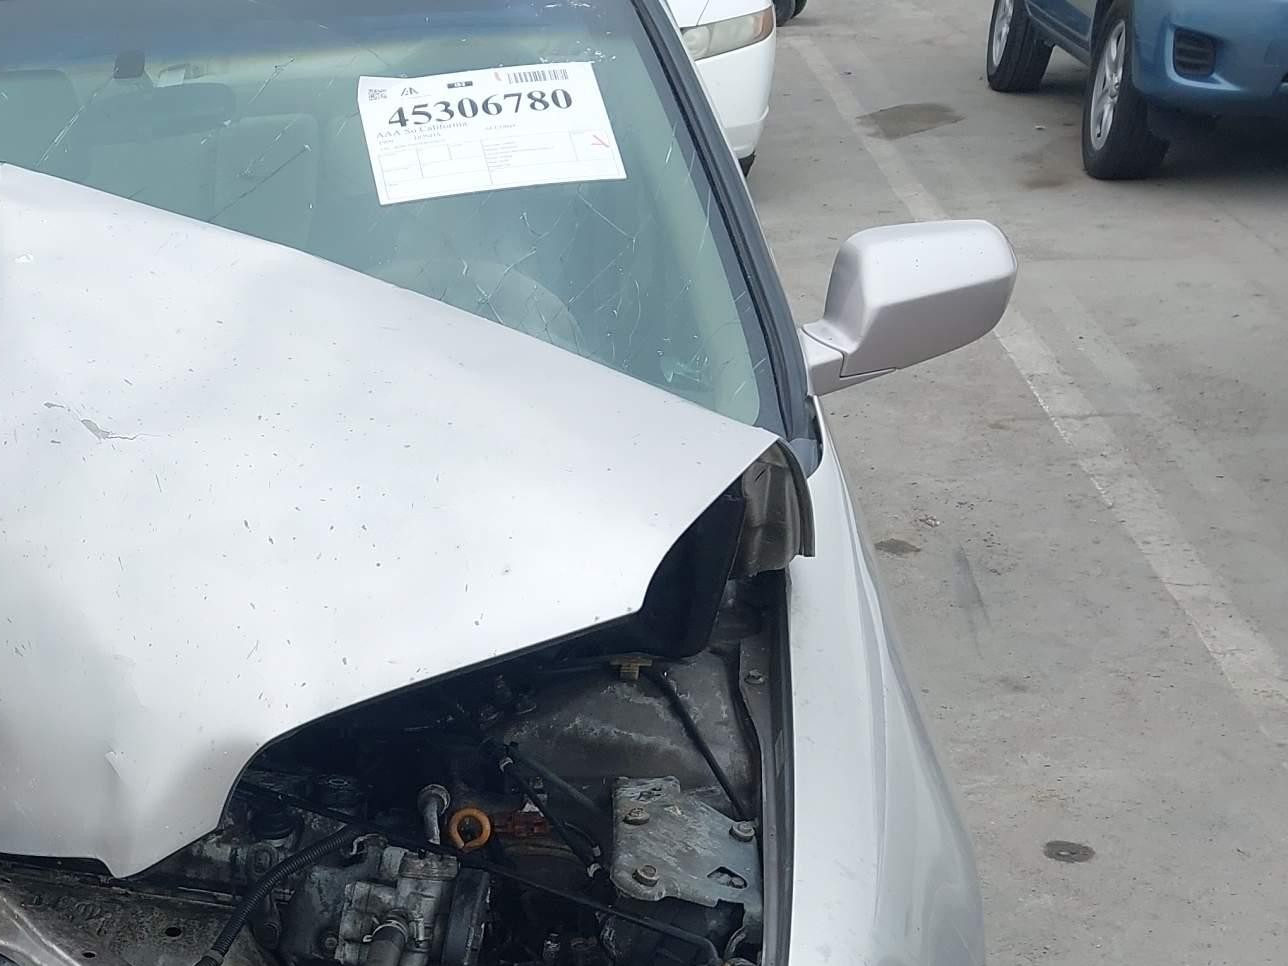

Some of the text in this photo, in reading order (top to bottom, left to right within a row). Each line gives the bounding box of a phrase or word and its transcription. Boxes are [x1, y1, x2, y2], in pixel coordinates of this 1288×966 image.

[388, 88, 573, 128] 45306780
[376, 131, 401, 140] AAA
[419, 121, 468, 133] California
